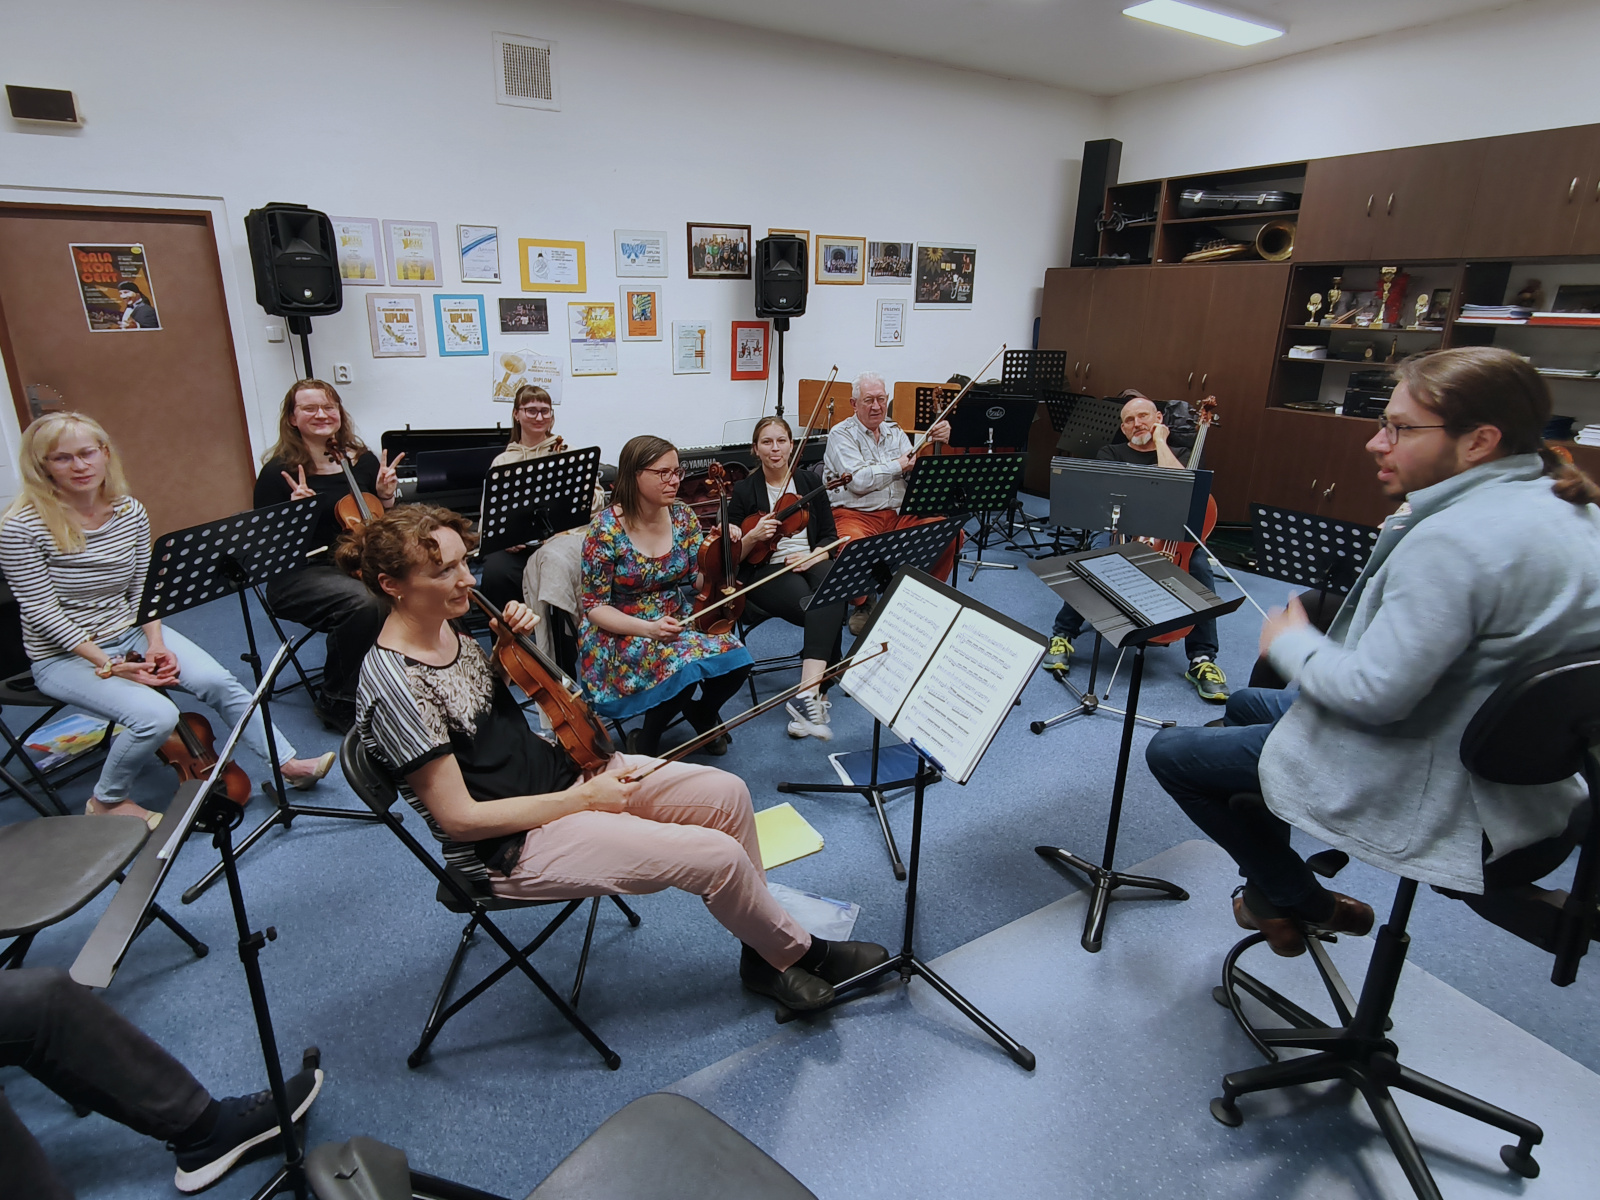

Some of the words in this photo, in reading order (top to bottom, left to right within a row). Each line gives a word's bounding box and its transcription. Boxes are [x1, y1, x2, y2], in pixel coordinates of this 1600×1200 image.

[79, 253, 113, 263] GALA
[82, 263, 114, 273] KON
[82, 273, 118, 283] CERT
